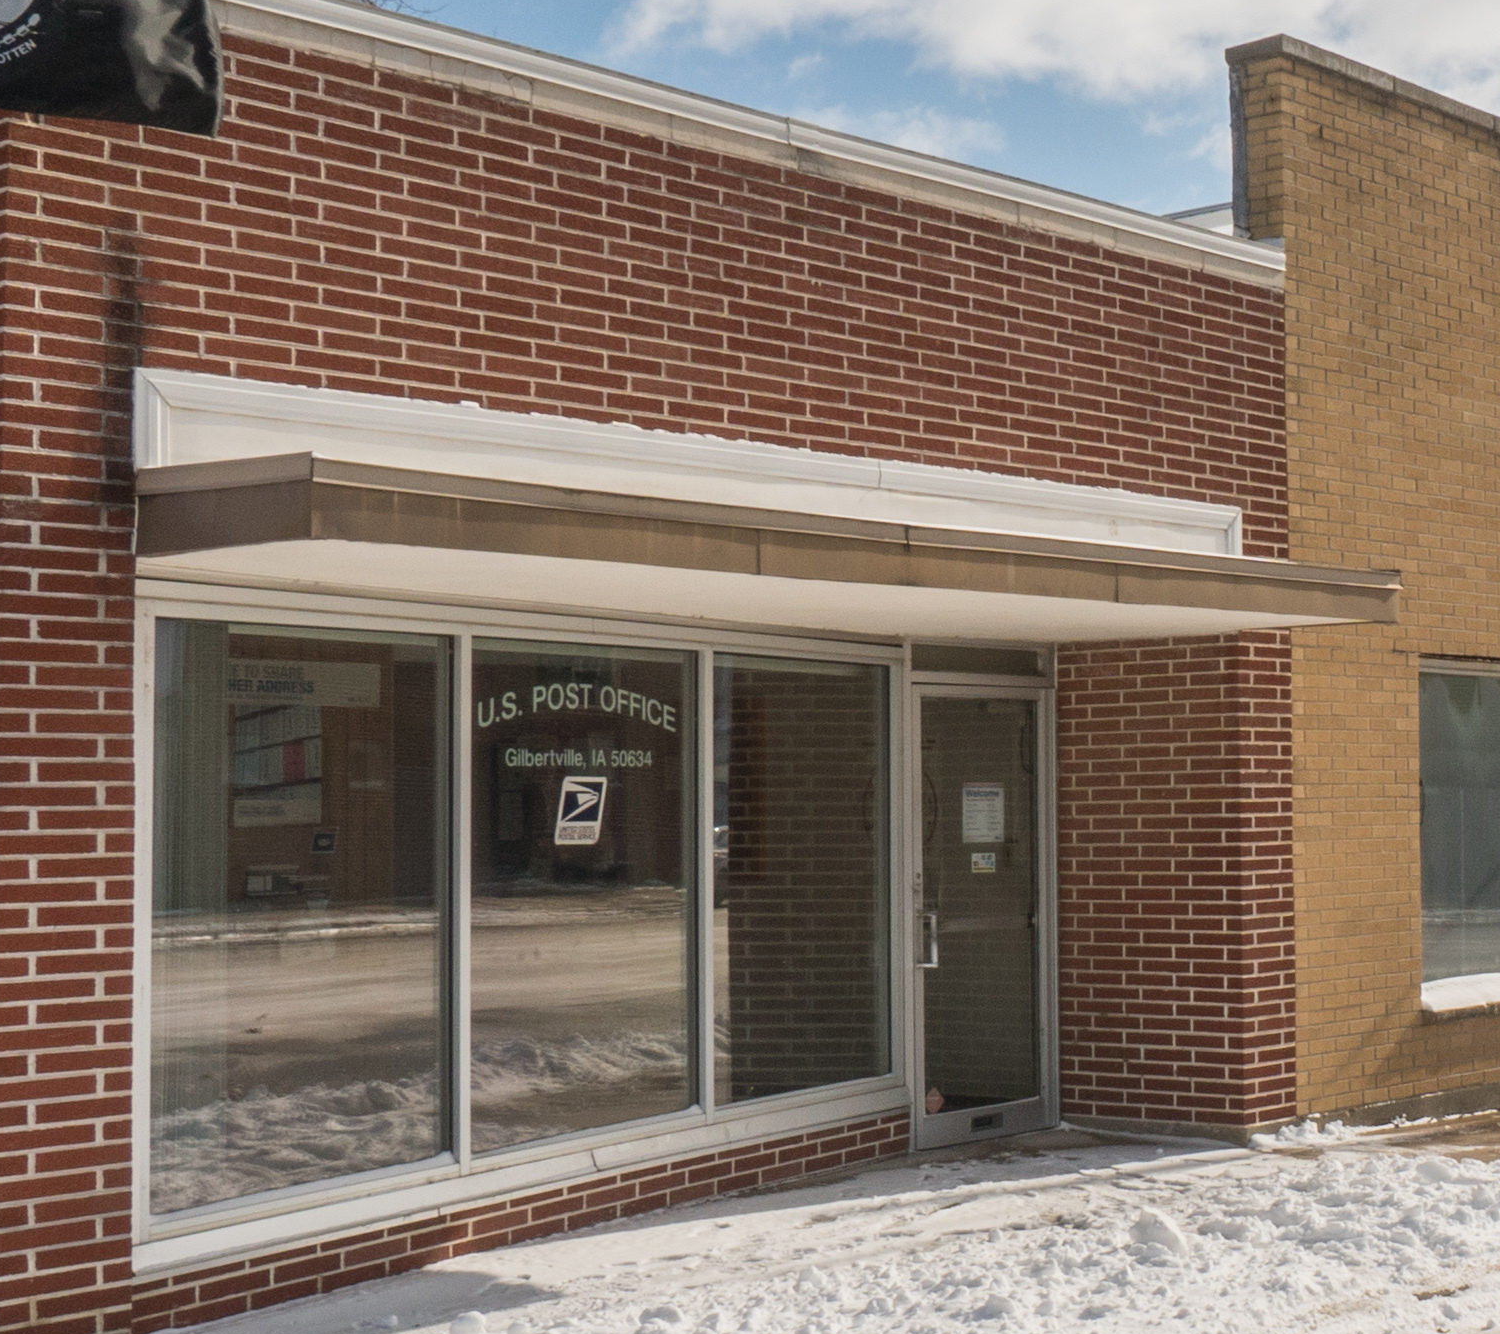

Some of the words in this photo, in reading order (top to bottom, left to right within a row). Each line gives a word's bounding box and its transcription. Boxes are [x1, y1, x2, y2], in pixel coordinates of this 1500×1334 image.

[257, 680, 314, 694] ADDRESS
[477, 690, 523, 728] U.S.
[532, 682, 593, 713] POST
[600, 685, 676, 733] OFFICE
[504, 747, 587, 769] Gilbertville,
[591, 748, 607, 767] IA
[610, 749, 653, 768] 50634
